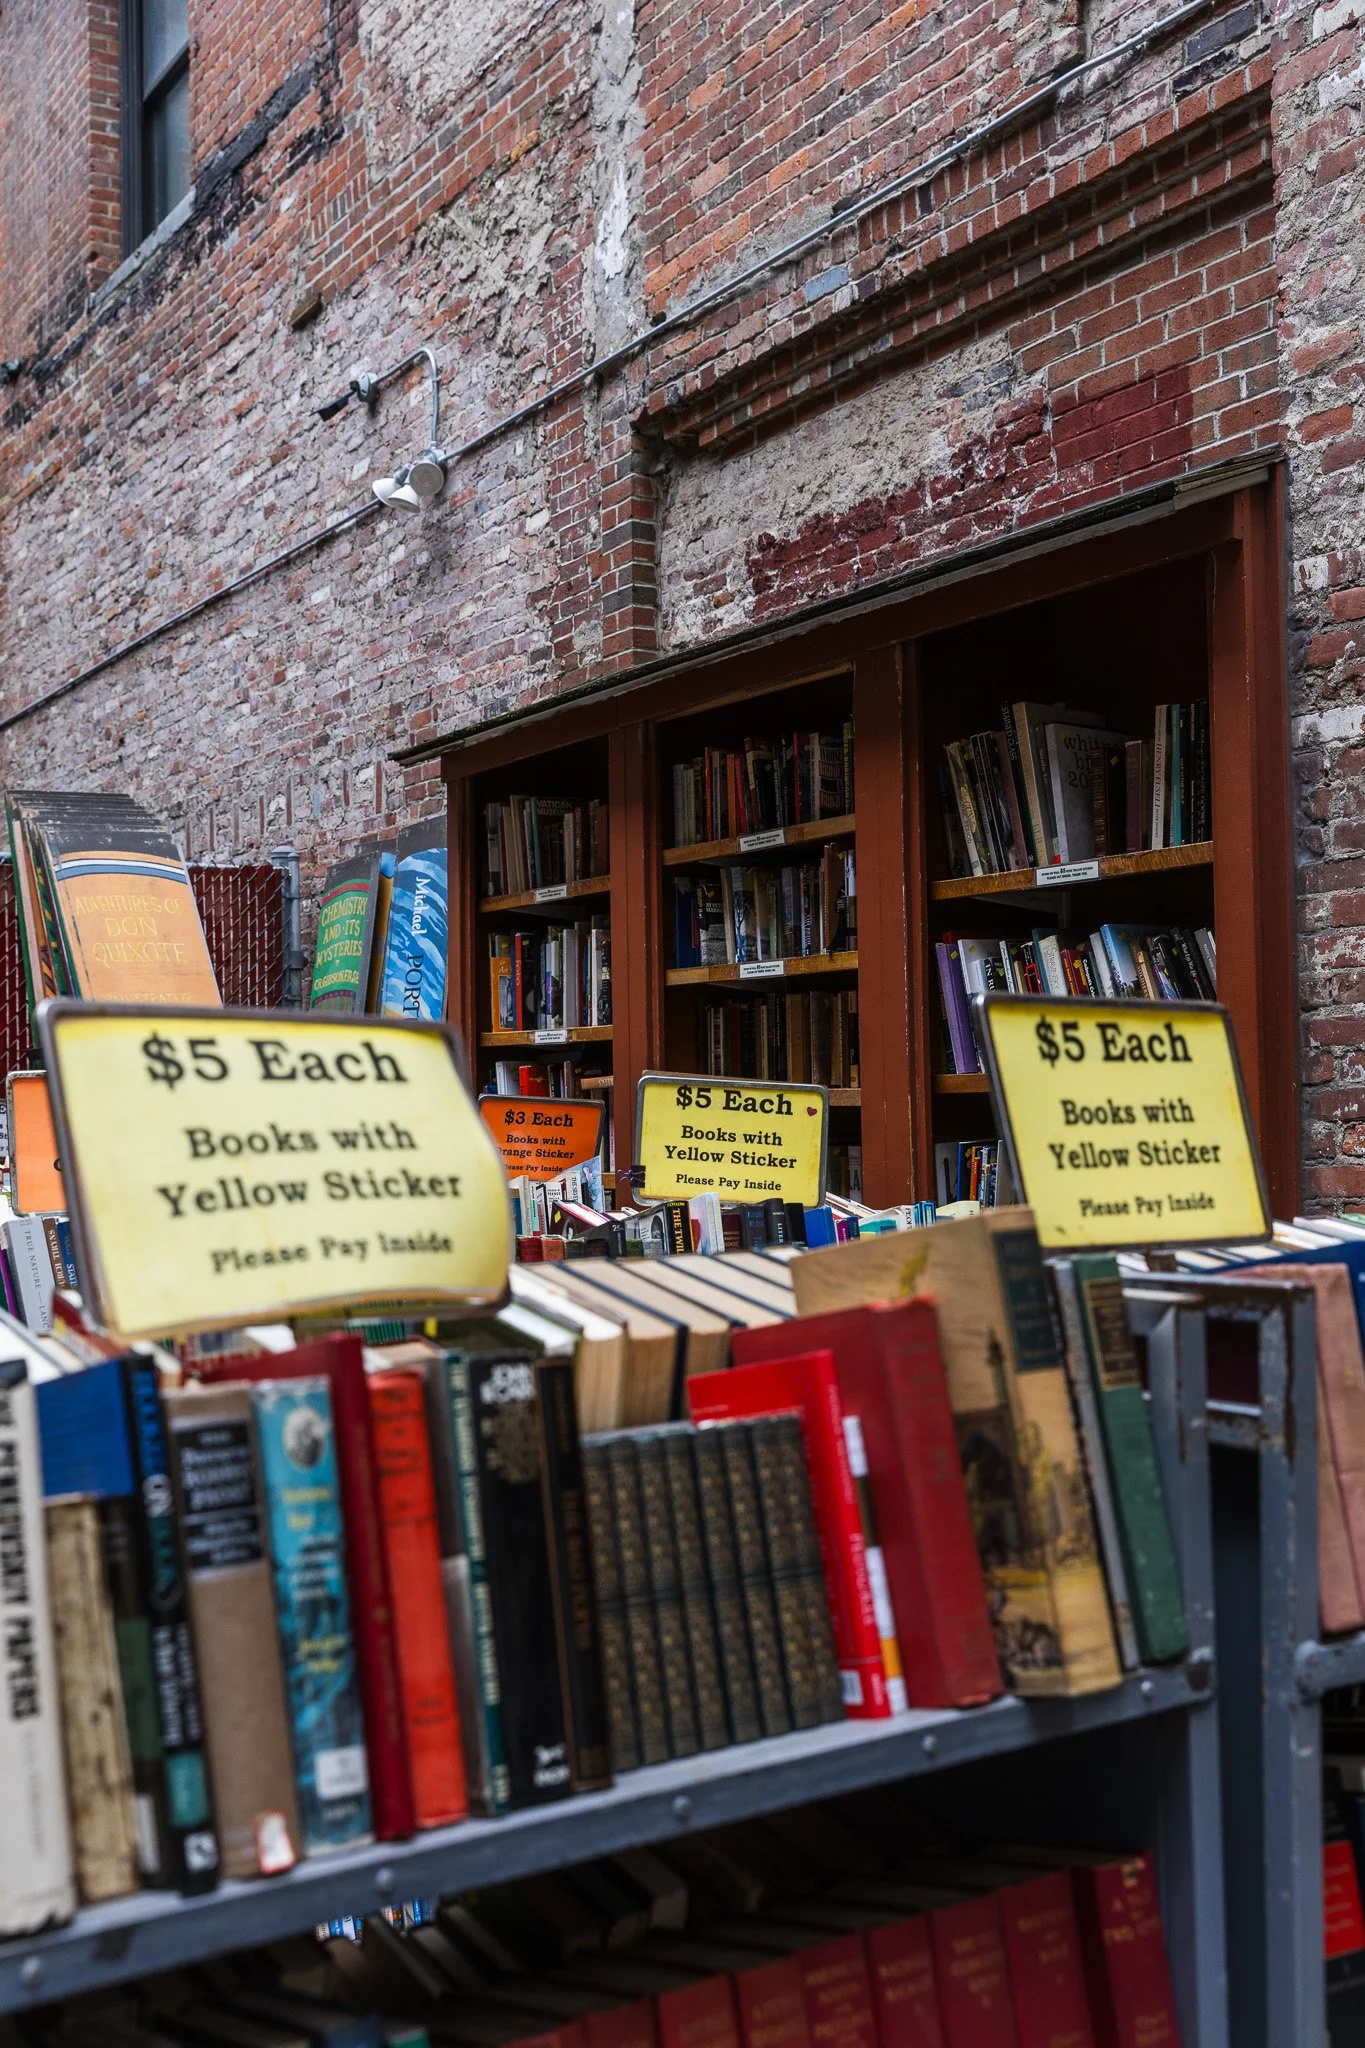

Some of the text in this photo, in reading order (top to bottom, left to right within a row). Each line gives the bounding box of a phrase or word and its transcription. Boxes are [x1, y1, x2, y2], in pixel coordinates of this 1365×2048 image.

[75, 894, 185, 915] ADVENTURES OF
[321, 896, 369, 927] CHEMISTRY
[411, 875, 432, 936] Michael
[104, 916, 158, 937] DON
[322, 919, 361, 945] AND ITS
[92, 941, 189, 969] QUIXOTE
[315, 940, 363, 968] MYSTERIES
[985, 964, 993, 976] IN
[1035, 1014, 1193, 1069] $5 Each
[141, 1030, 409, 1091] $5 Each
[675, 1084, 794, 1116] $5 Each
[1060, 1096, 1195, 1125] Books with
[504, 1108, 574, 1128] $3 Each
[184, 1120, 418, 1160] Books with
[505, 1134, 566, 1146] Books with
[680, 1124, 783, 1146] Books with
[535, 1148, 575, 1159] Sticker
[664, 1145, 798, 1169] Yellow Sticker
[1047, 1139, 1221, 1170] Yellow Sticker
[505, 1164, 563, 1173] lease Pay Inside
[675, 1173, 782, 1191] Please Pay Inside
[157, 1167, 463, 1219] Yellow Sticker
[1078, 1192, 1215, 1218] Please Pay Inside
[672, 1207, 683, 1228] THE
[24, 1230, 35, 1253] TRUE
[210, 1231, 454, 1276] Please Pay Inside
[29, 1254, 42, 1289] NATURE
[48, 1230, 66, 1288] URCH TIRYNS
